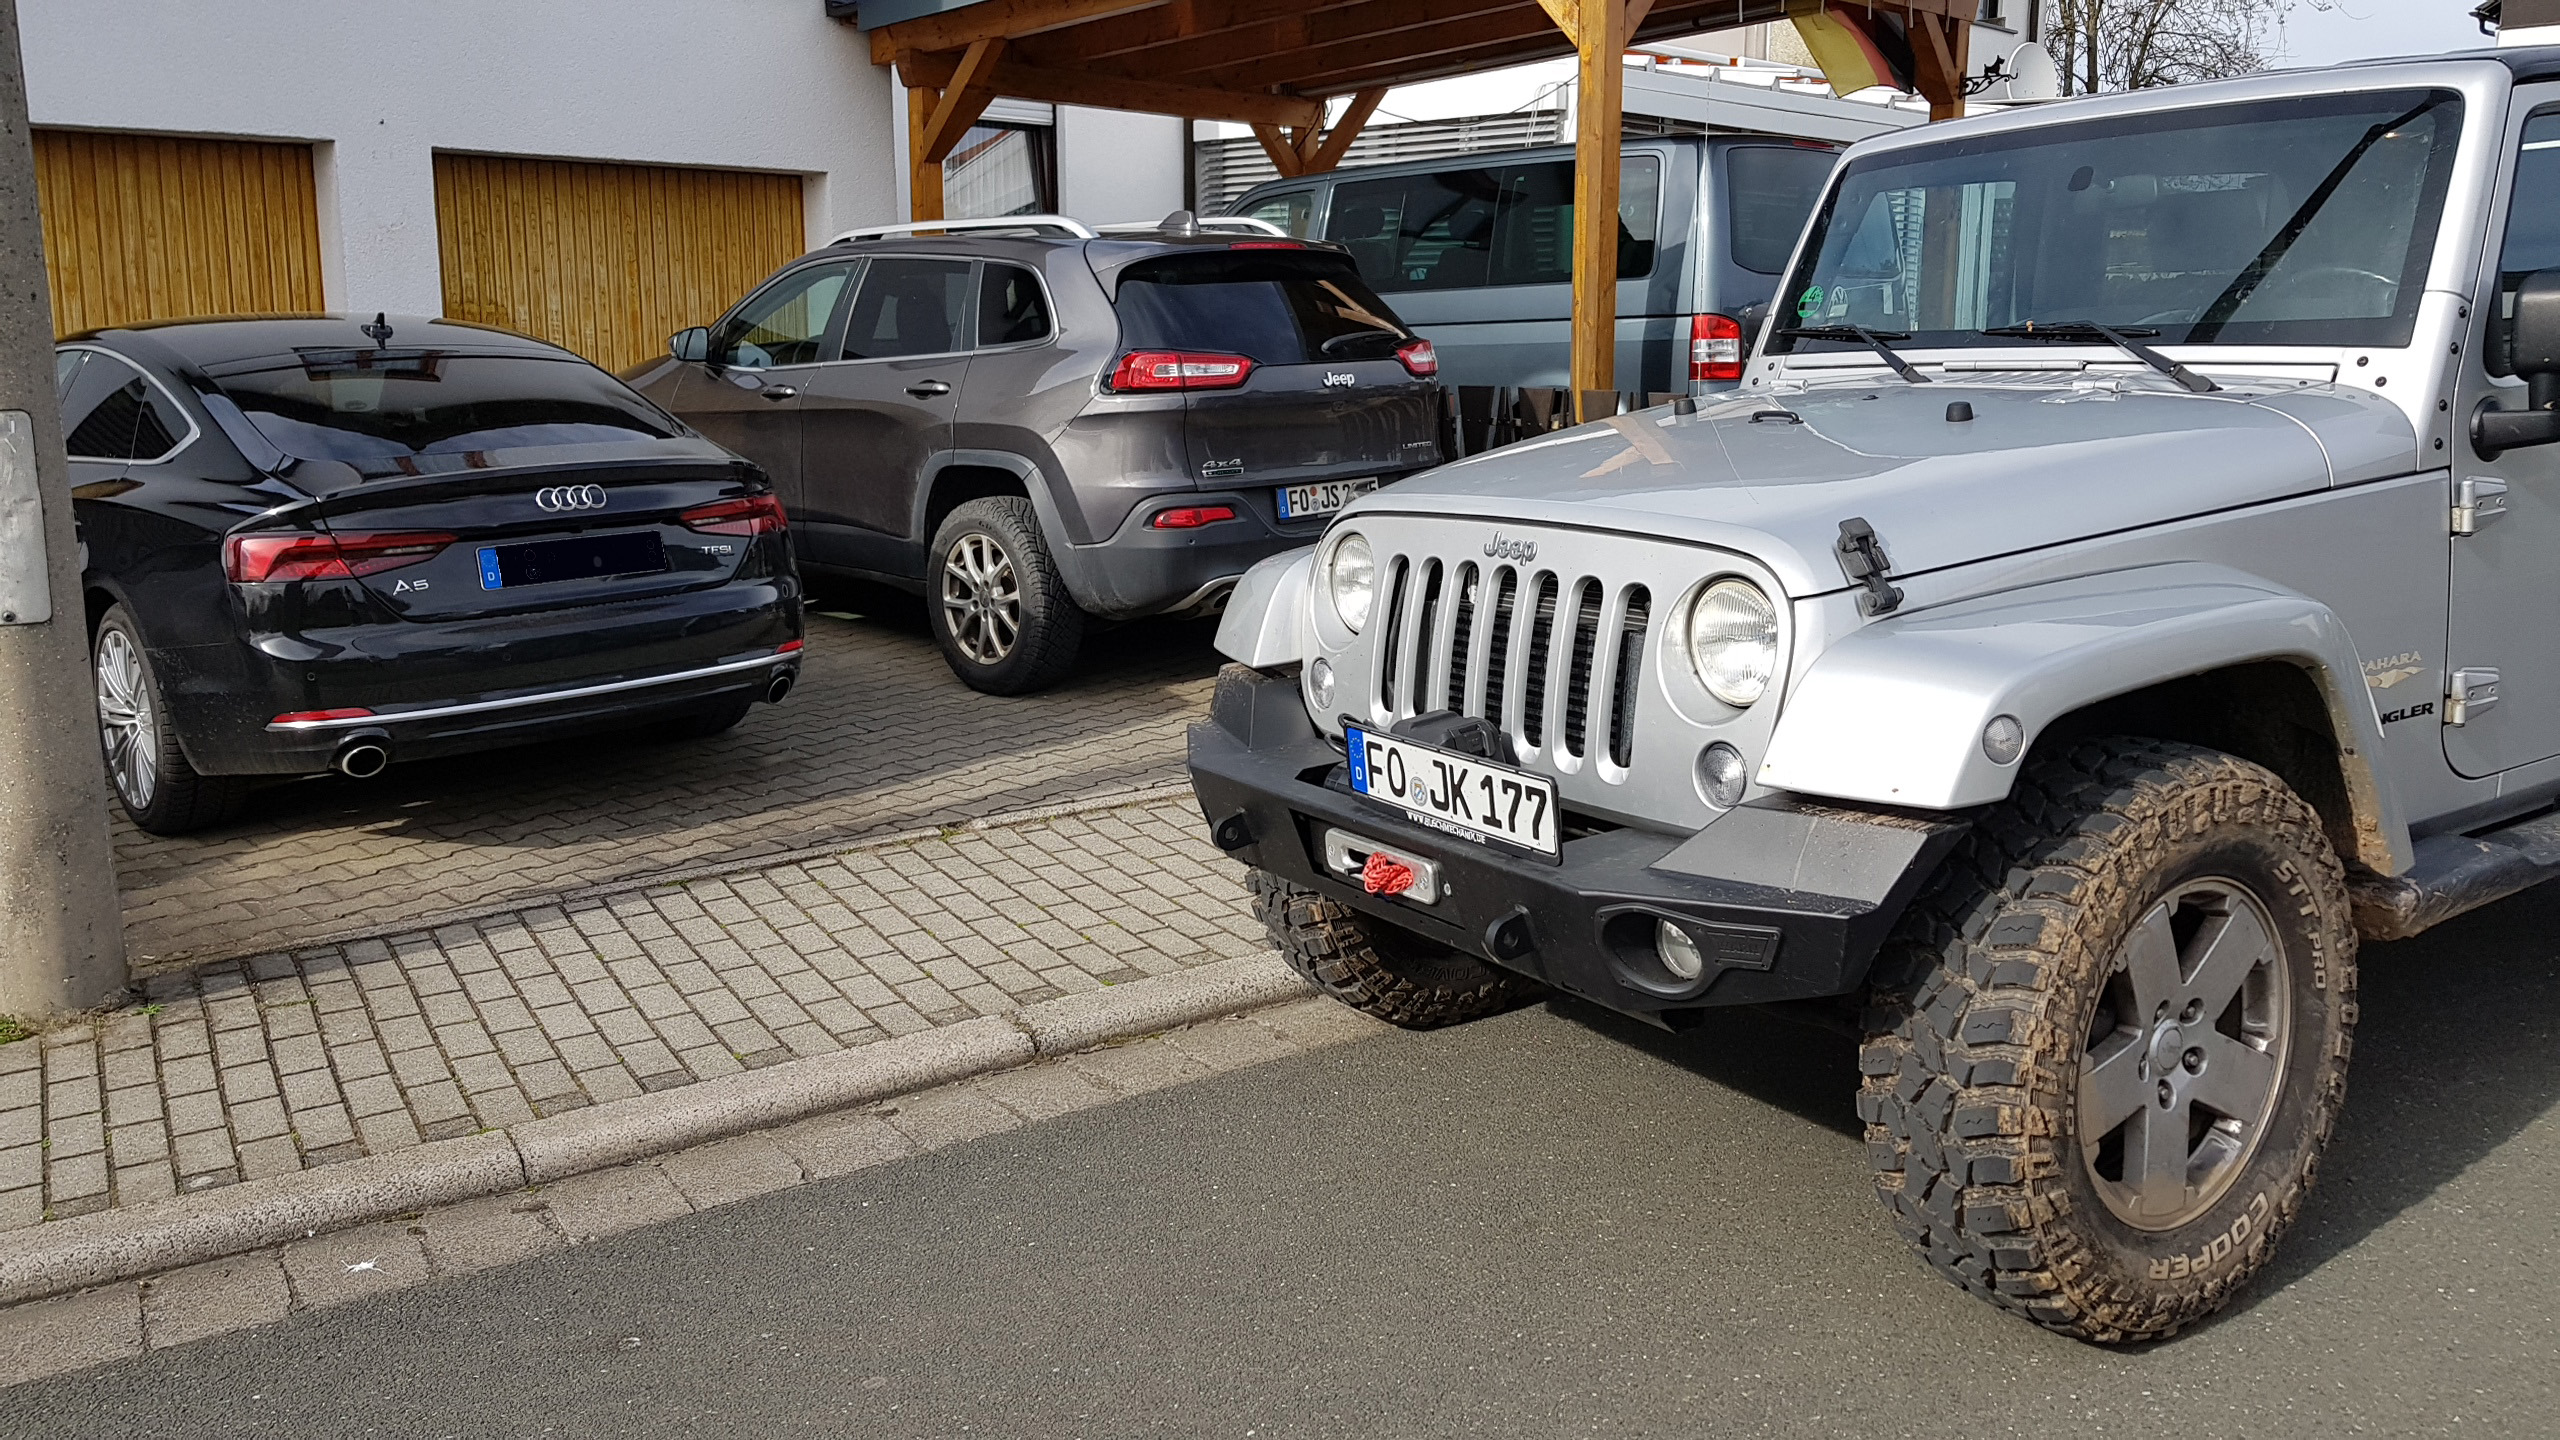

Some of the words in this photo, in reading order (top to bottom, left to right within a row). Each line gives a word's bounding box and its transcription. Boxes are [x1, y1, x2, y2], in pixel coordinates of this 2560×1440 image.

[1323, 371, 1355, 387] Jeep
[1402, 440, 1432, 450] LIMITED
[1202, 458, 1242, 468] 4x4
[1288, 488, 1310, 513] FO
[1321, 484, 1340, 509] JS
[701, 545, 732, 555] TFSI
[1484, 531, 1538, 566] Jeep
[487, 571, 495, 581] D
[392, 579, 430, 596] A5
[1355, 766, 1363, 780] D
[1366, 740, 1406, 798] FO
[1430, 759, 1473, 820] JK
[1480, 775, 1547, 841] 177
[2272, 860, 2320, 917] STT
[2308, 932, 2326, 989] PRO
[2149, 1192, 2269, 1280] COOPER
